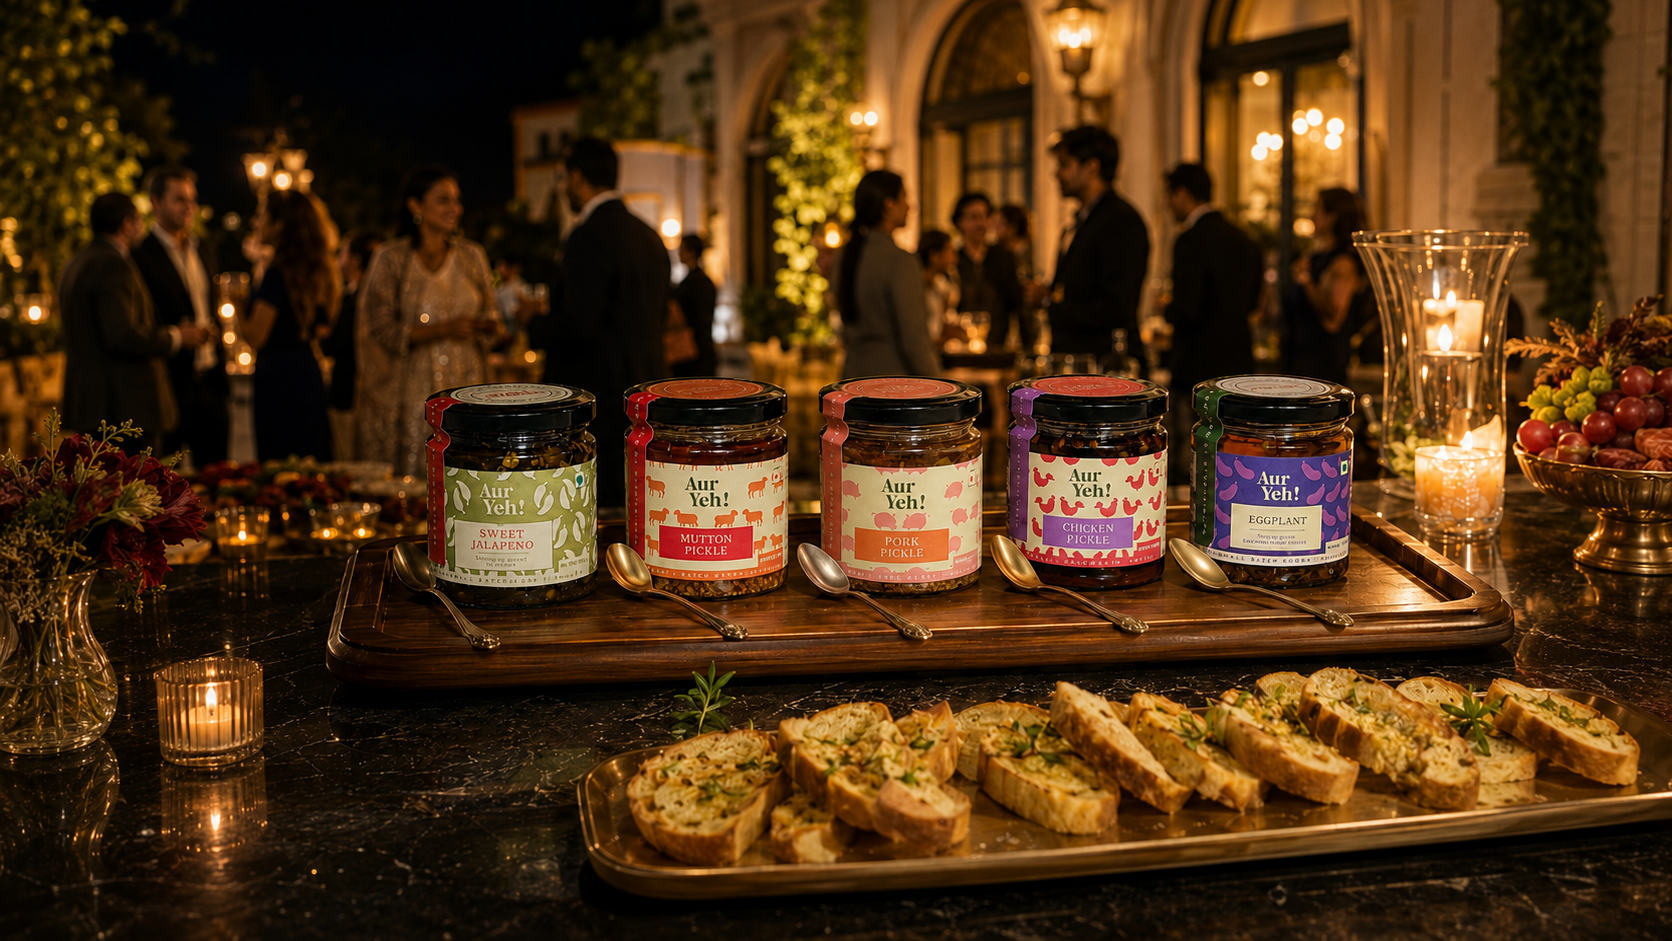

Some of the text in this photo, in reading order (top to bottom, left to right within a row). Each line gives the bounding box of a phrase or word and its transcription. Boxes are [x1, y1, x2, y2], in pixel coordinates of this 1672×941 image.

[1069, 468, 1102, 482] Aur
[1257, 471, 1290, 485] Aur
[479, 483, 514, 498] Aur
[685, 477, 719, 491] Aur
[881, 478, 916, 493] Aur
[1072, 483, 1111, 498] Yeh!
[689, 492, 729, 507] Yeh!
[1260, 486, 1300, 501] Yeh!
[483, 499, 525, 515] Yeh!
[886, 494, 926, 509] Yeh!
[1248, 515, 1308, 525] EGGPLANT
[479, 528, 525, 539] SWEET
[1062, 522, 1114, 533] CHICKEN
[471, 540, 534, 550] JALAPENO
[680, 533, 732, 544] MUTTON
[885, 536, 919, 546] PORK
[1066, 534, 1110, 545] PICKLE
[684, 546, 728, 556] PICKLE
[880, 548, 924, 558] PICKLE
